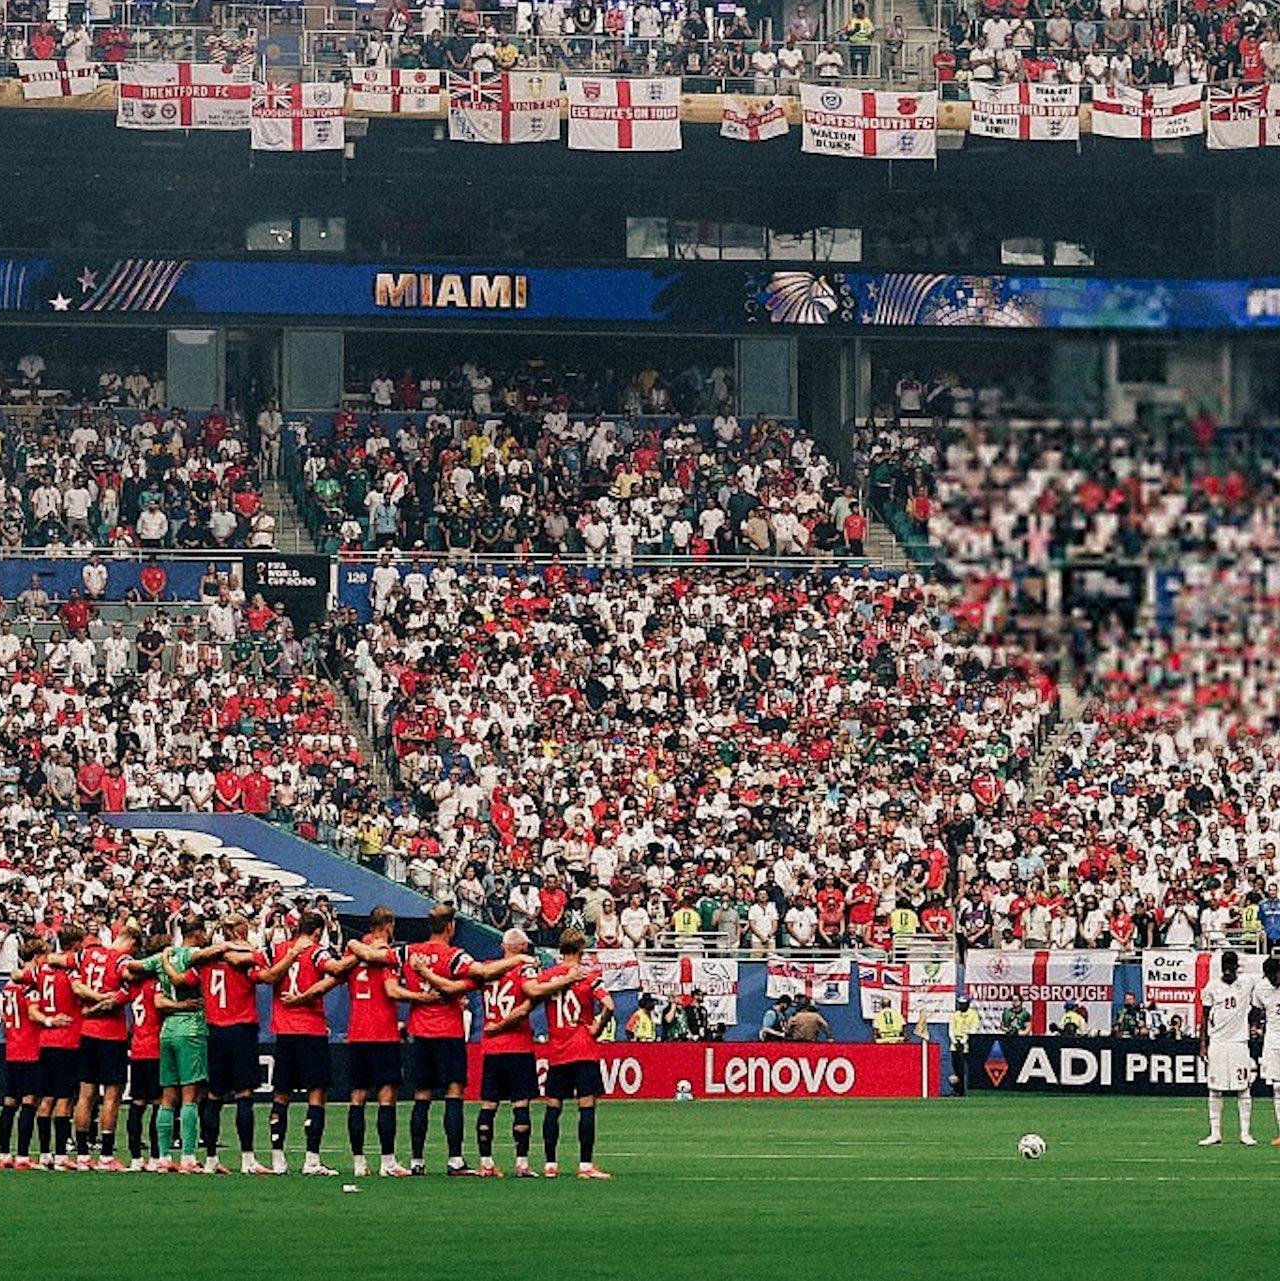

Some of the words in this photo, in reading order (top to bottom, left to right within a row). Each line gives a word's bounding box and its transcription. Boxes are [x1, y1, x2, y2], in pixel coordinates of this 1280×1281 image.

[142, 86, 208, 99] BRENTFORD
[215, 86, 229, 98] FC
[805, 111, 910, 130] PORTSMOUTH
[915, 117, 935, 129] FC
[375, 273, 527, 308] MIAMI
[1153, 956, 1184, 968] Our
[210, 969, 227, 1009] 9
[1147, 970, 1188, 982] Mate
[969, 984, 1109, 1002] MIDDLESBROUGH
[1147, 987, 1196, 1002] Jimmy
[131, 989, 146, 1027] 6
[550, 989, 582, 1029] 10
[704, 1047, 856, 1095] Lenovo
[1016, 1046, 1113, 1086] ADI
